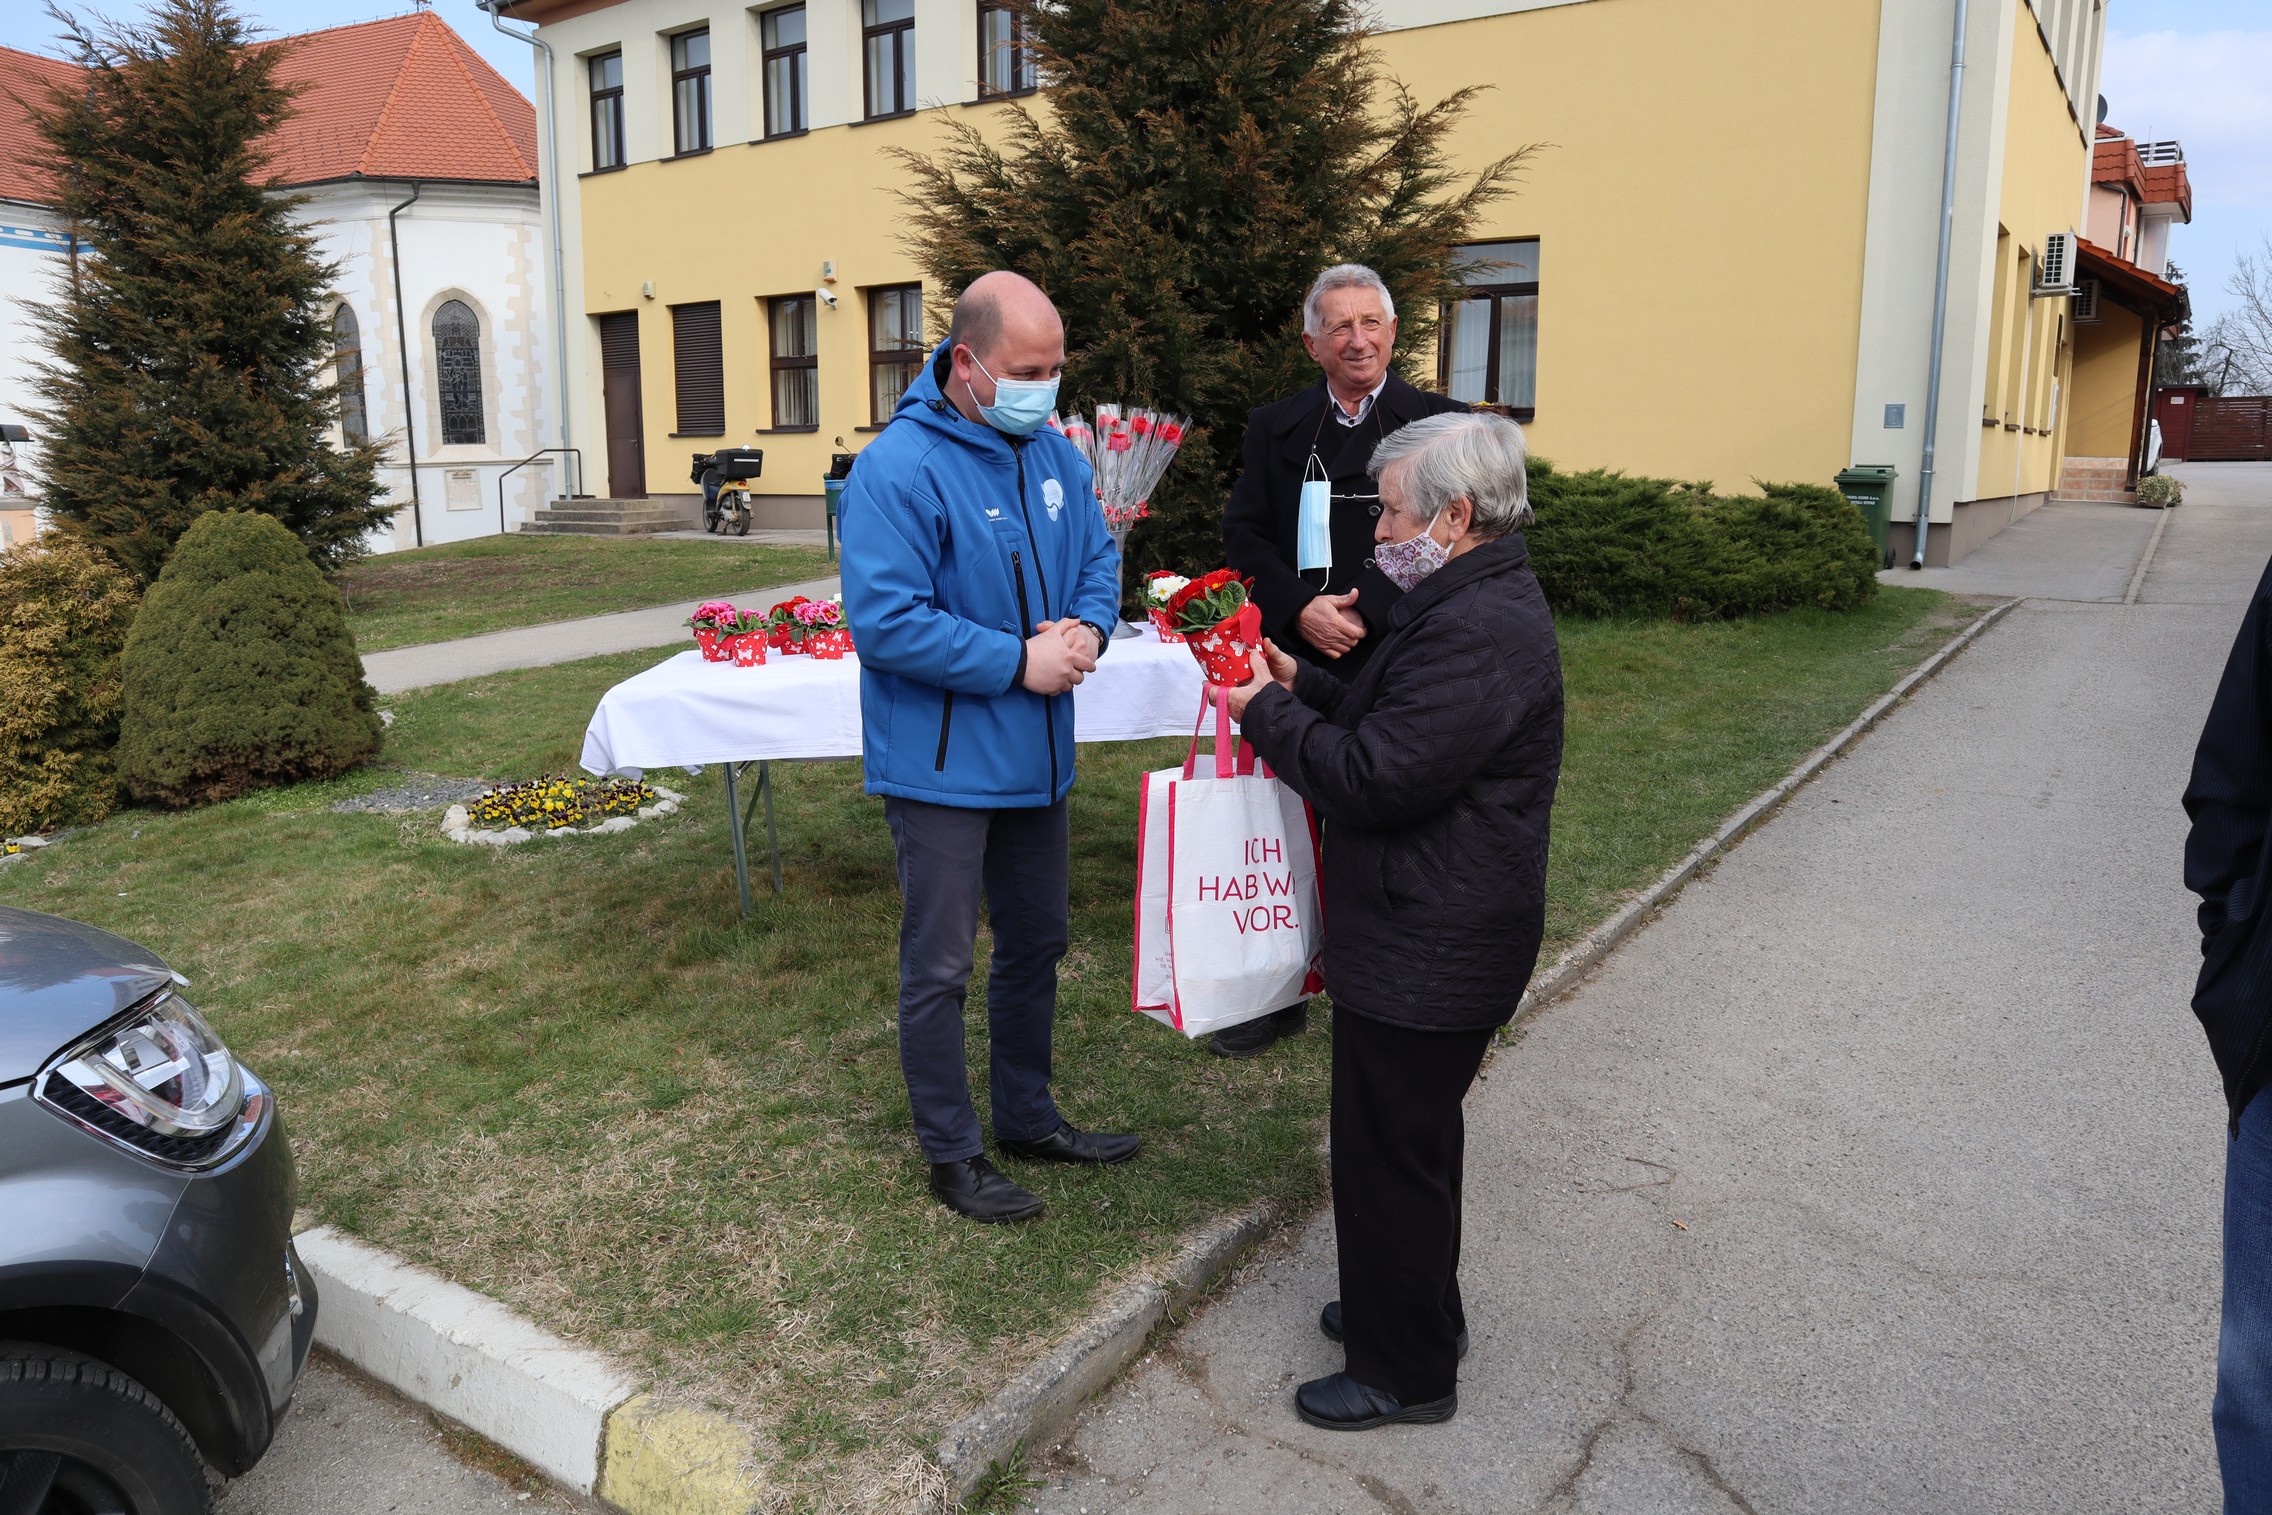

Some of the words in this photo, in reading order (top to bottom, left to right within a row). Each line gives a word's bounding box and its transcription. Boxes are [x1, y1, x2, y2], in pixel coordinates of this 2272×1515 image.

[1245, 838, 1282, 866] ICH
[1199, 874, 1258, 902] HAB
[1262, 870, 1296, 897] W
[1232, 905, 1299, 935] VOR.
